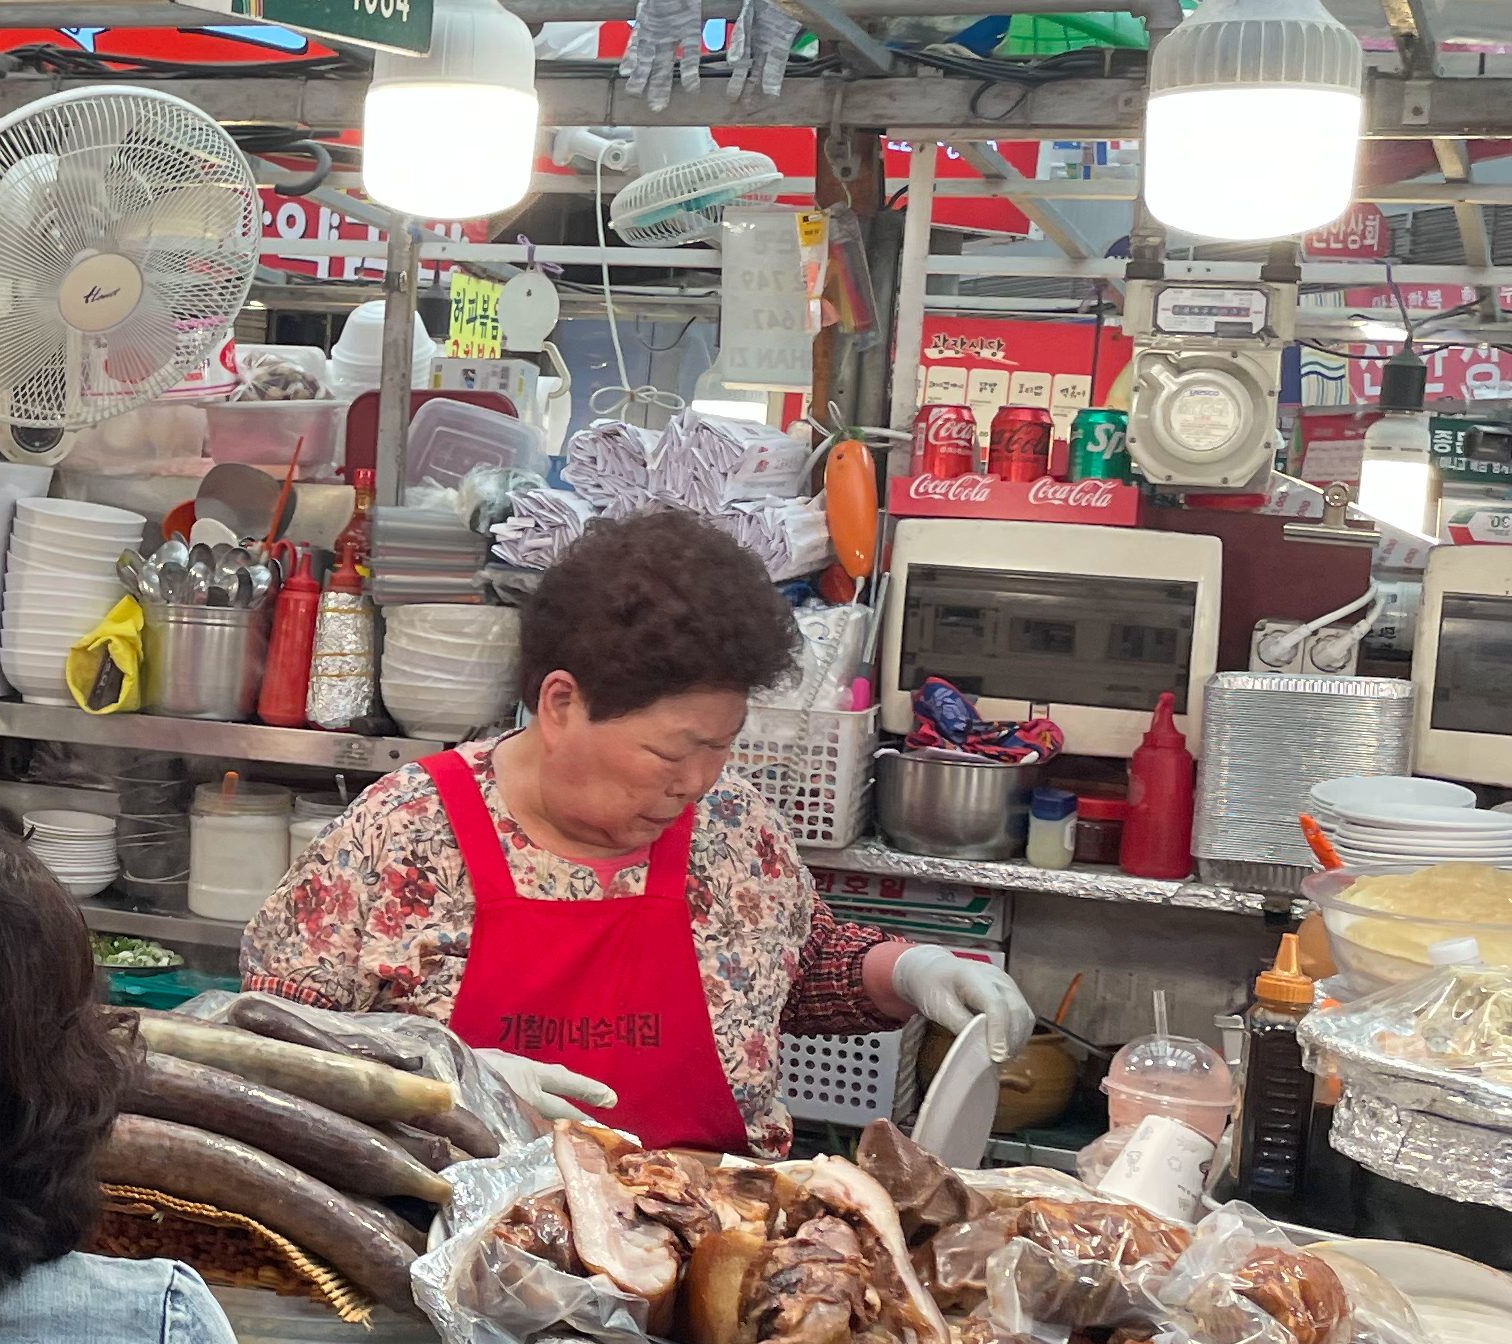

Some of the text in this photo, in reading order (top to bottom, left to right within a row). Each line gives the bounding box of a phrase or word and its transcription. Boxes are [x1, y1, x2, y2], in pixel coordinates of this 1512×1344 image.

[932, 334, 1006, 358] 광장식당
[910, 473, 995, 502] Coca-Cola
[1028, 476, 1119, 508] Coca-Cola
[497, 1012, 662, 1051] 기철이네순대집
